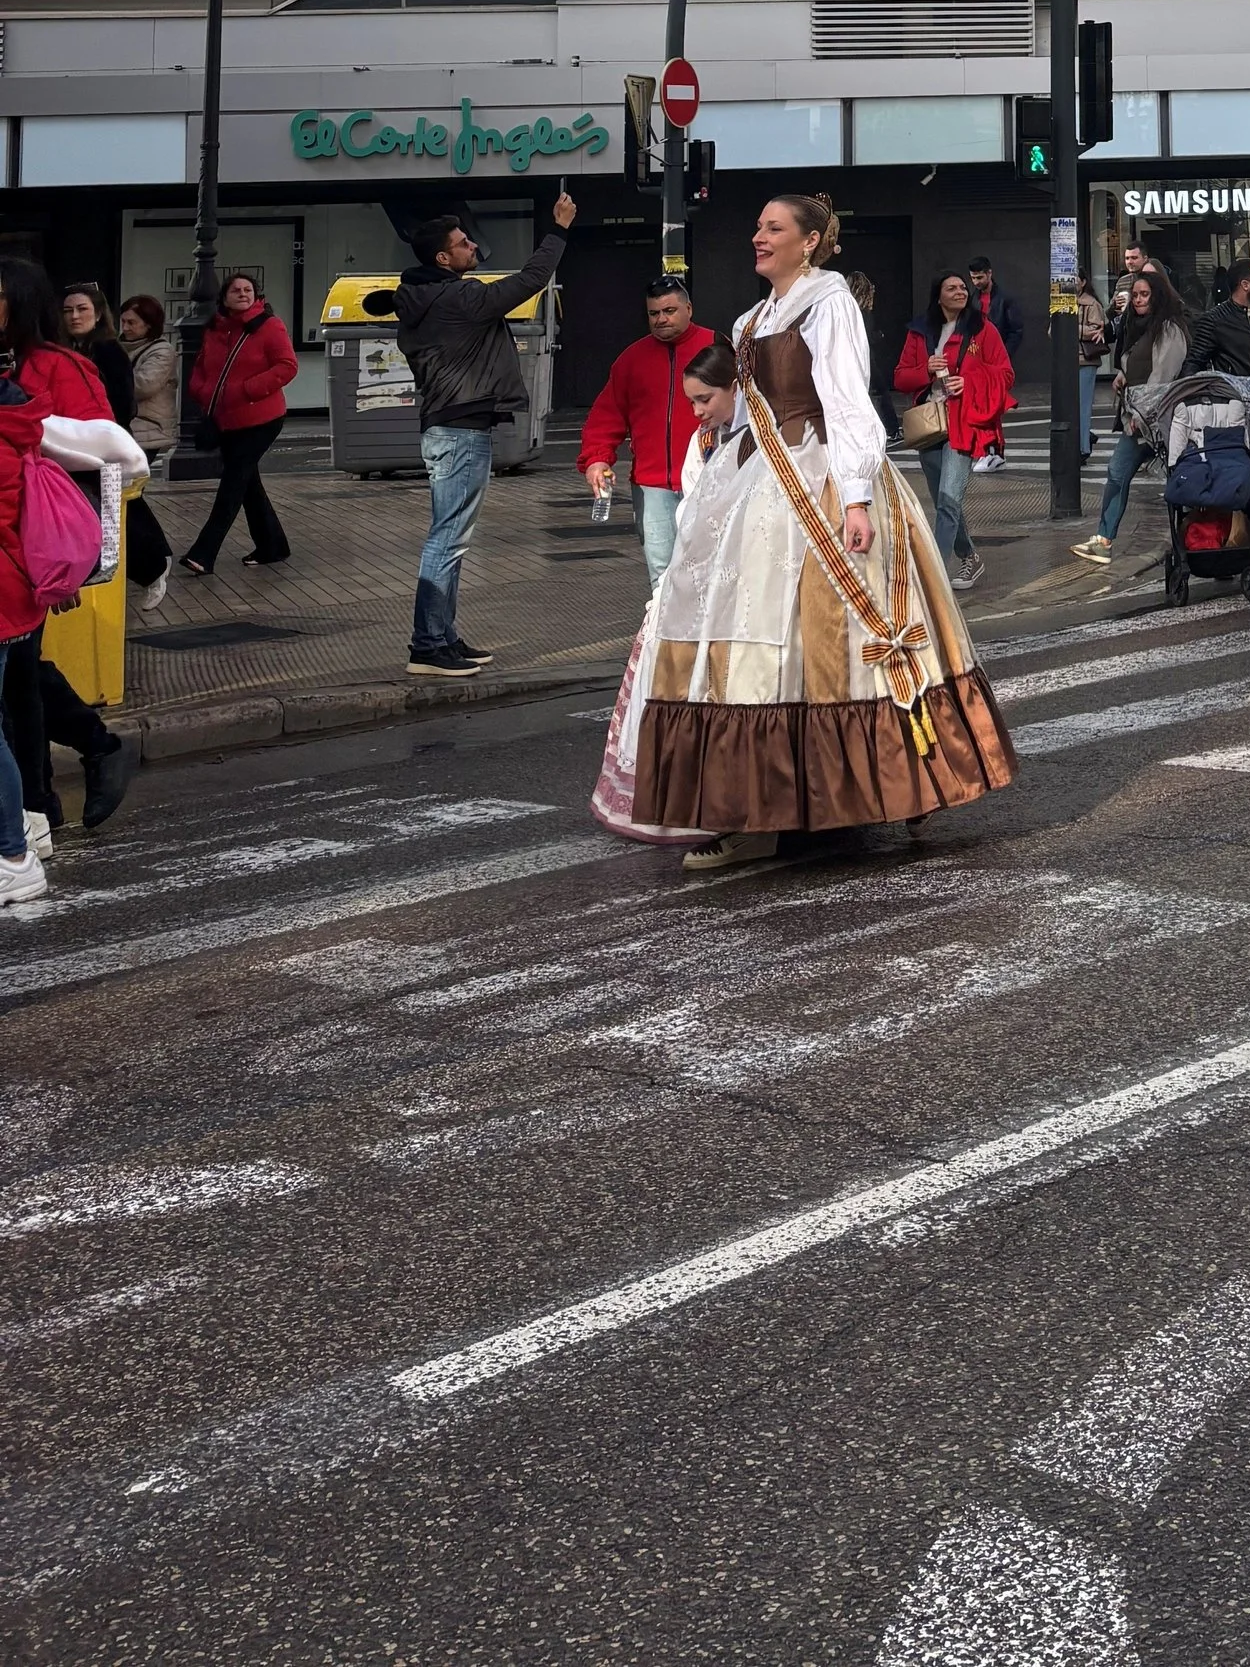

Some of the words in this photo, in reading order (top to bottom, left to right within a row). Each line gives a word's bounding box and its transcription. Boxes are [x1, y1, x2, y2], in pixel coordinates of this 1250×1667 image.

[290, 110, 338, 159] El
[340, 110, 447, 158] Corte
[453, 97, 609, 174] Inglés
